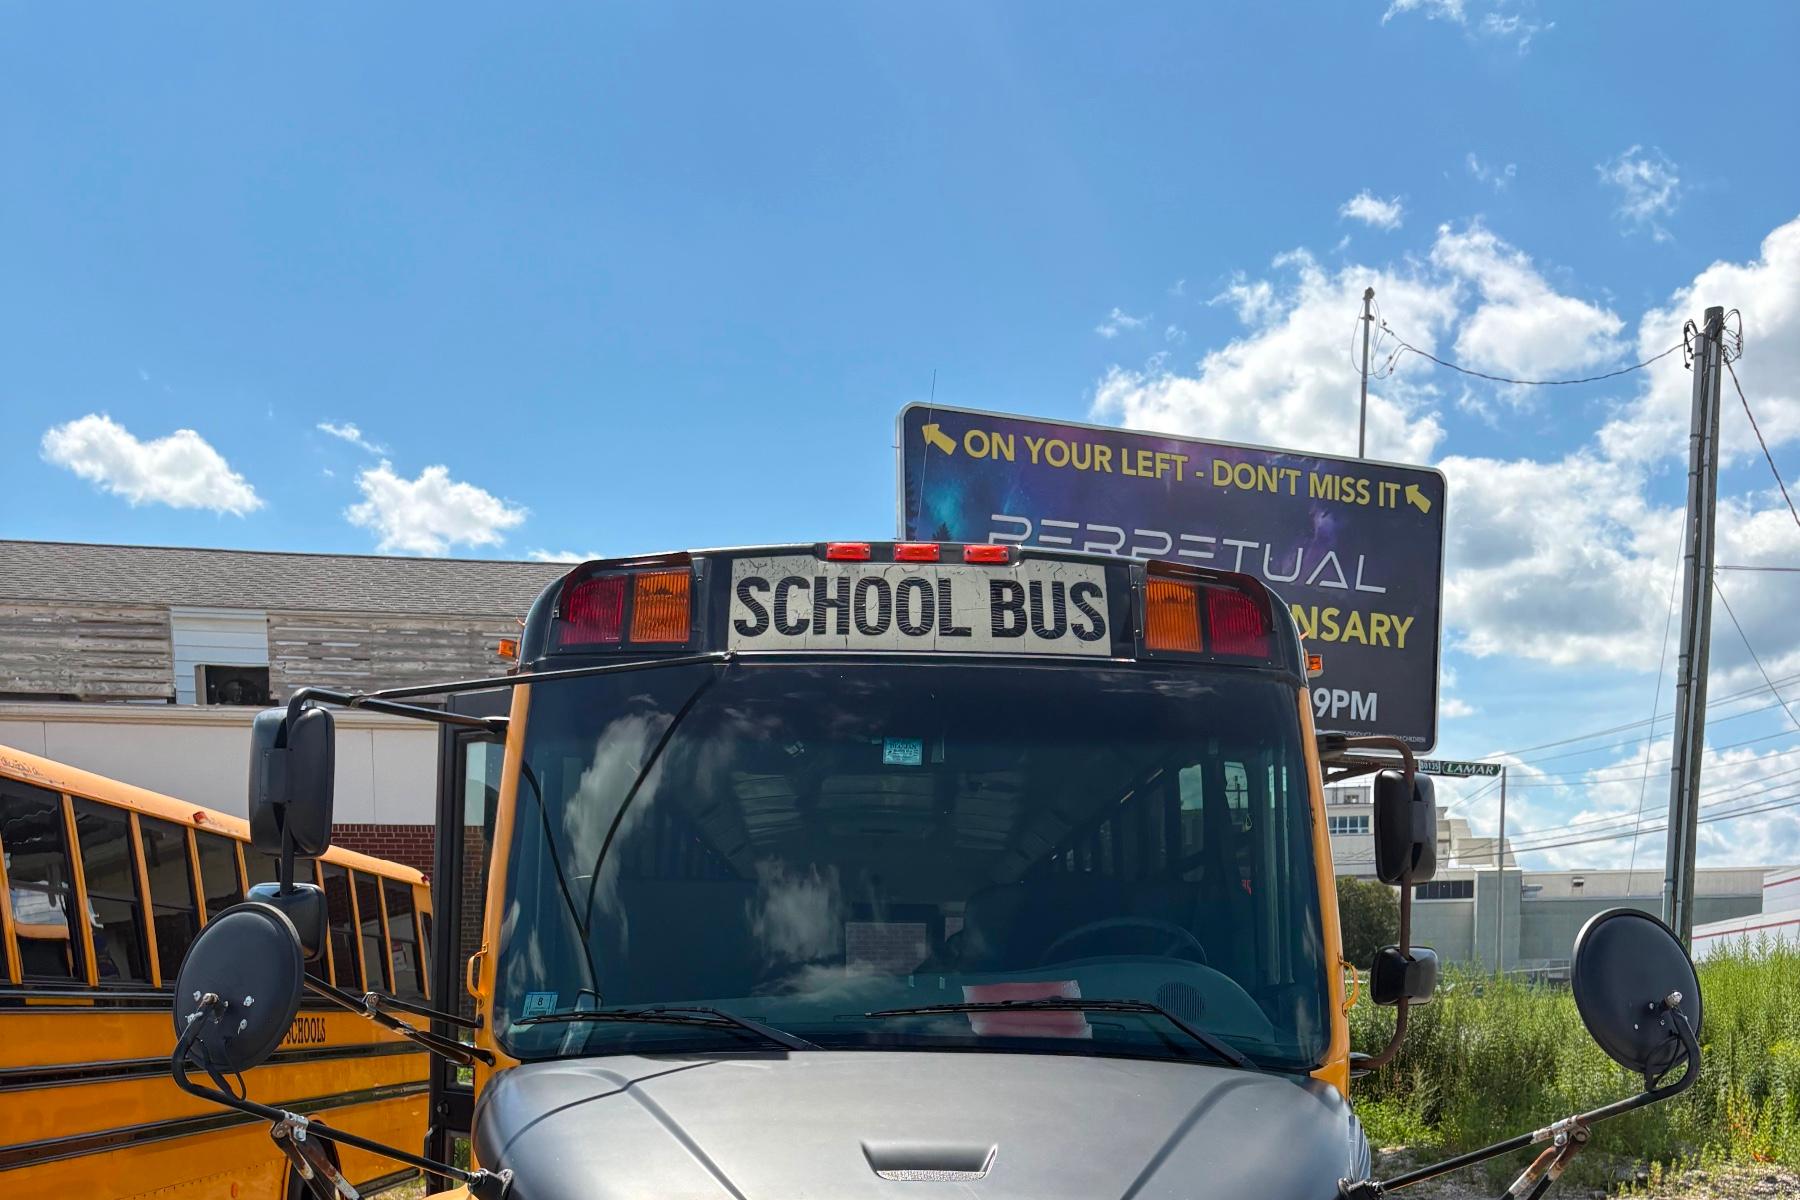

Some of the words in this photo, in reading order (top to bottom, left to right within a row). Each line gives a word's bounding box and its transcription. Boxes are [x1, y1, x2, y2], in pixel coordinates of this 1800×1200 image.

[963, 429, 1015, 462] ON
[1024, 436, 1113, 473] YOUR
[1121, 448, 1189, 481] LEFT
[1212, 459, 1301, 496] DON'T
[1309, 473, 1371, 505] MISS
[1378, 481, 1400, 508] IT
[988, 514, 1387, 593] PERPETUAL
[733, 575, 972, 638] SCHOOL
[990, 578, 1108, 642] BUS
[1312, 687, 1378, 722] 9PM
[1446, 763, 1494, 775] LAMAR
